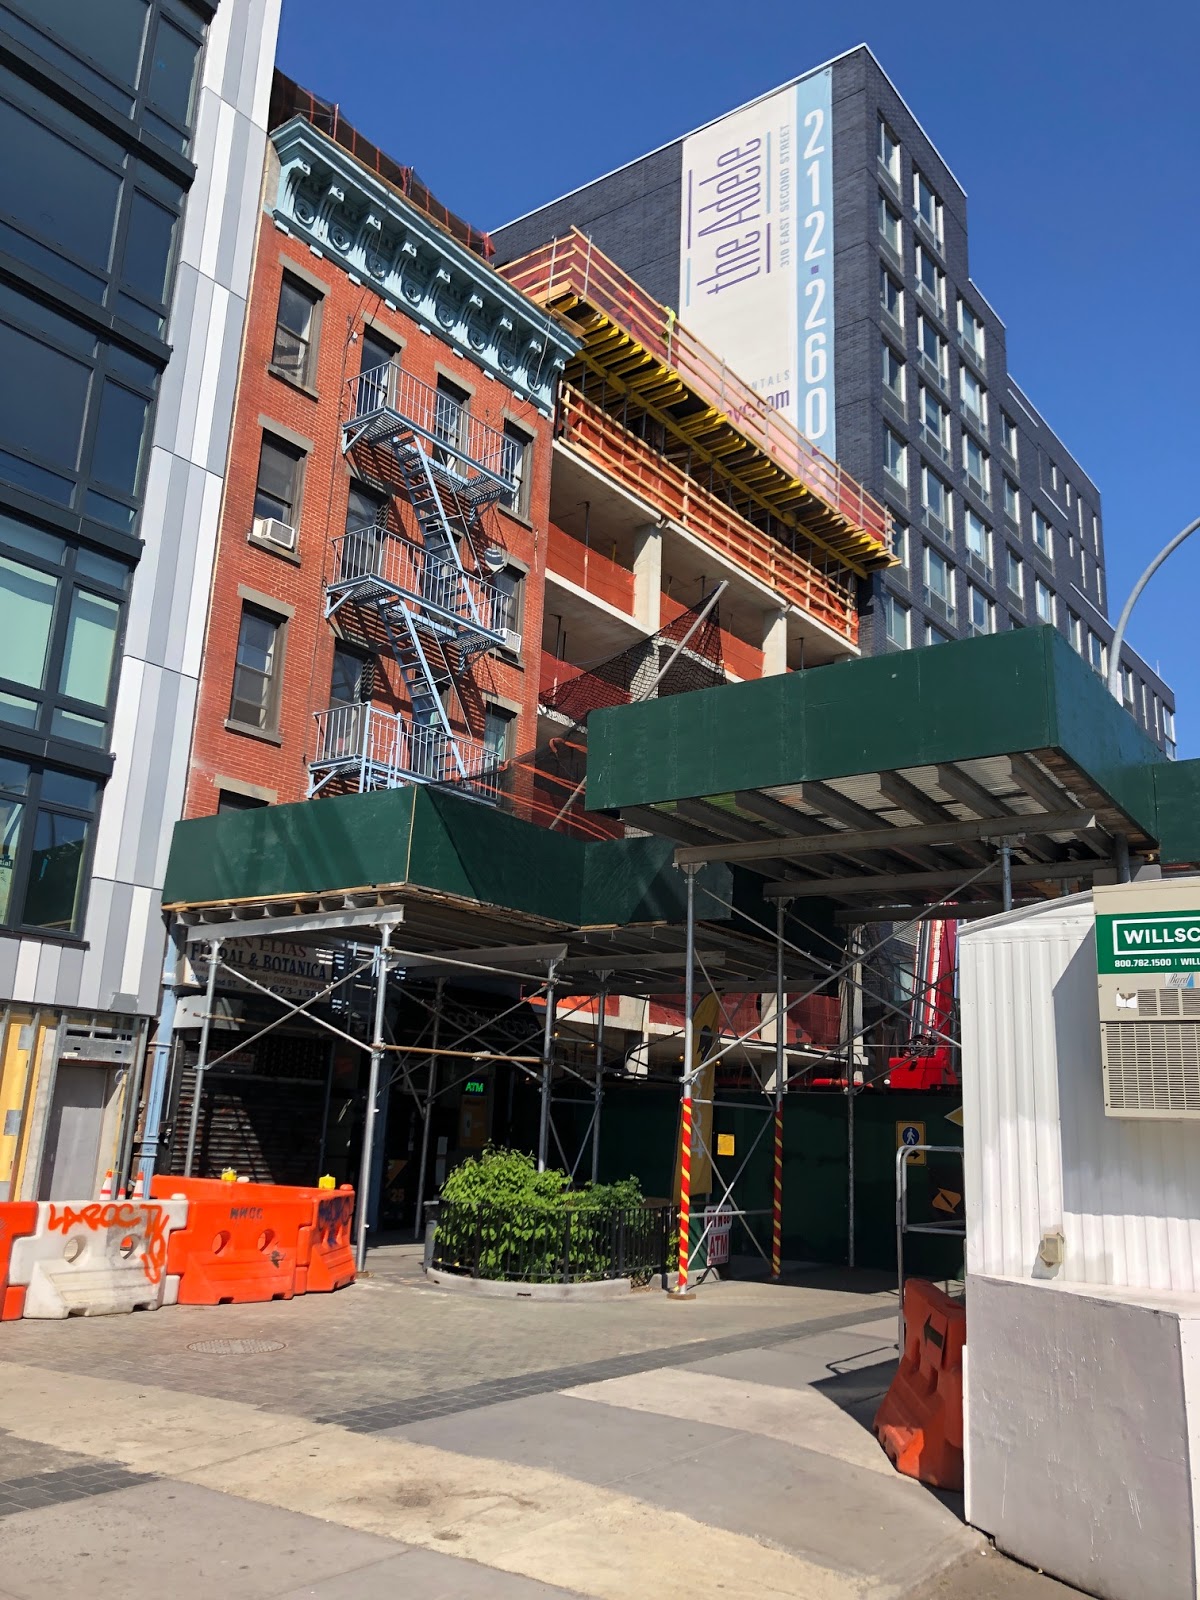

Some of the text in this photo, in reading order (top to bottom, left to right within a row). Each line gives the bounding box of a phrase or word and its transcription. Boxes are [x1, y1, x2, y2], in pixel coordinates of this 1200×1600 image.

[780, 124, 790, 267] 310 EAST SECOND STREET
[697, 137, 762, 295] the Adele
[260, 938, 306, 958] ELIAS
[250, 953, 259, 967] &
[264, 954, 327, 979] BOTANICA
[1114, 958, 1172, 967] 800.782.1500
[465, 1081, 484, 1093] ATM
[709, 1234, 728, 1257] ATM
